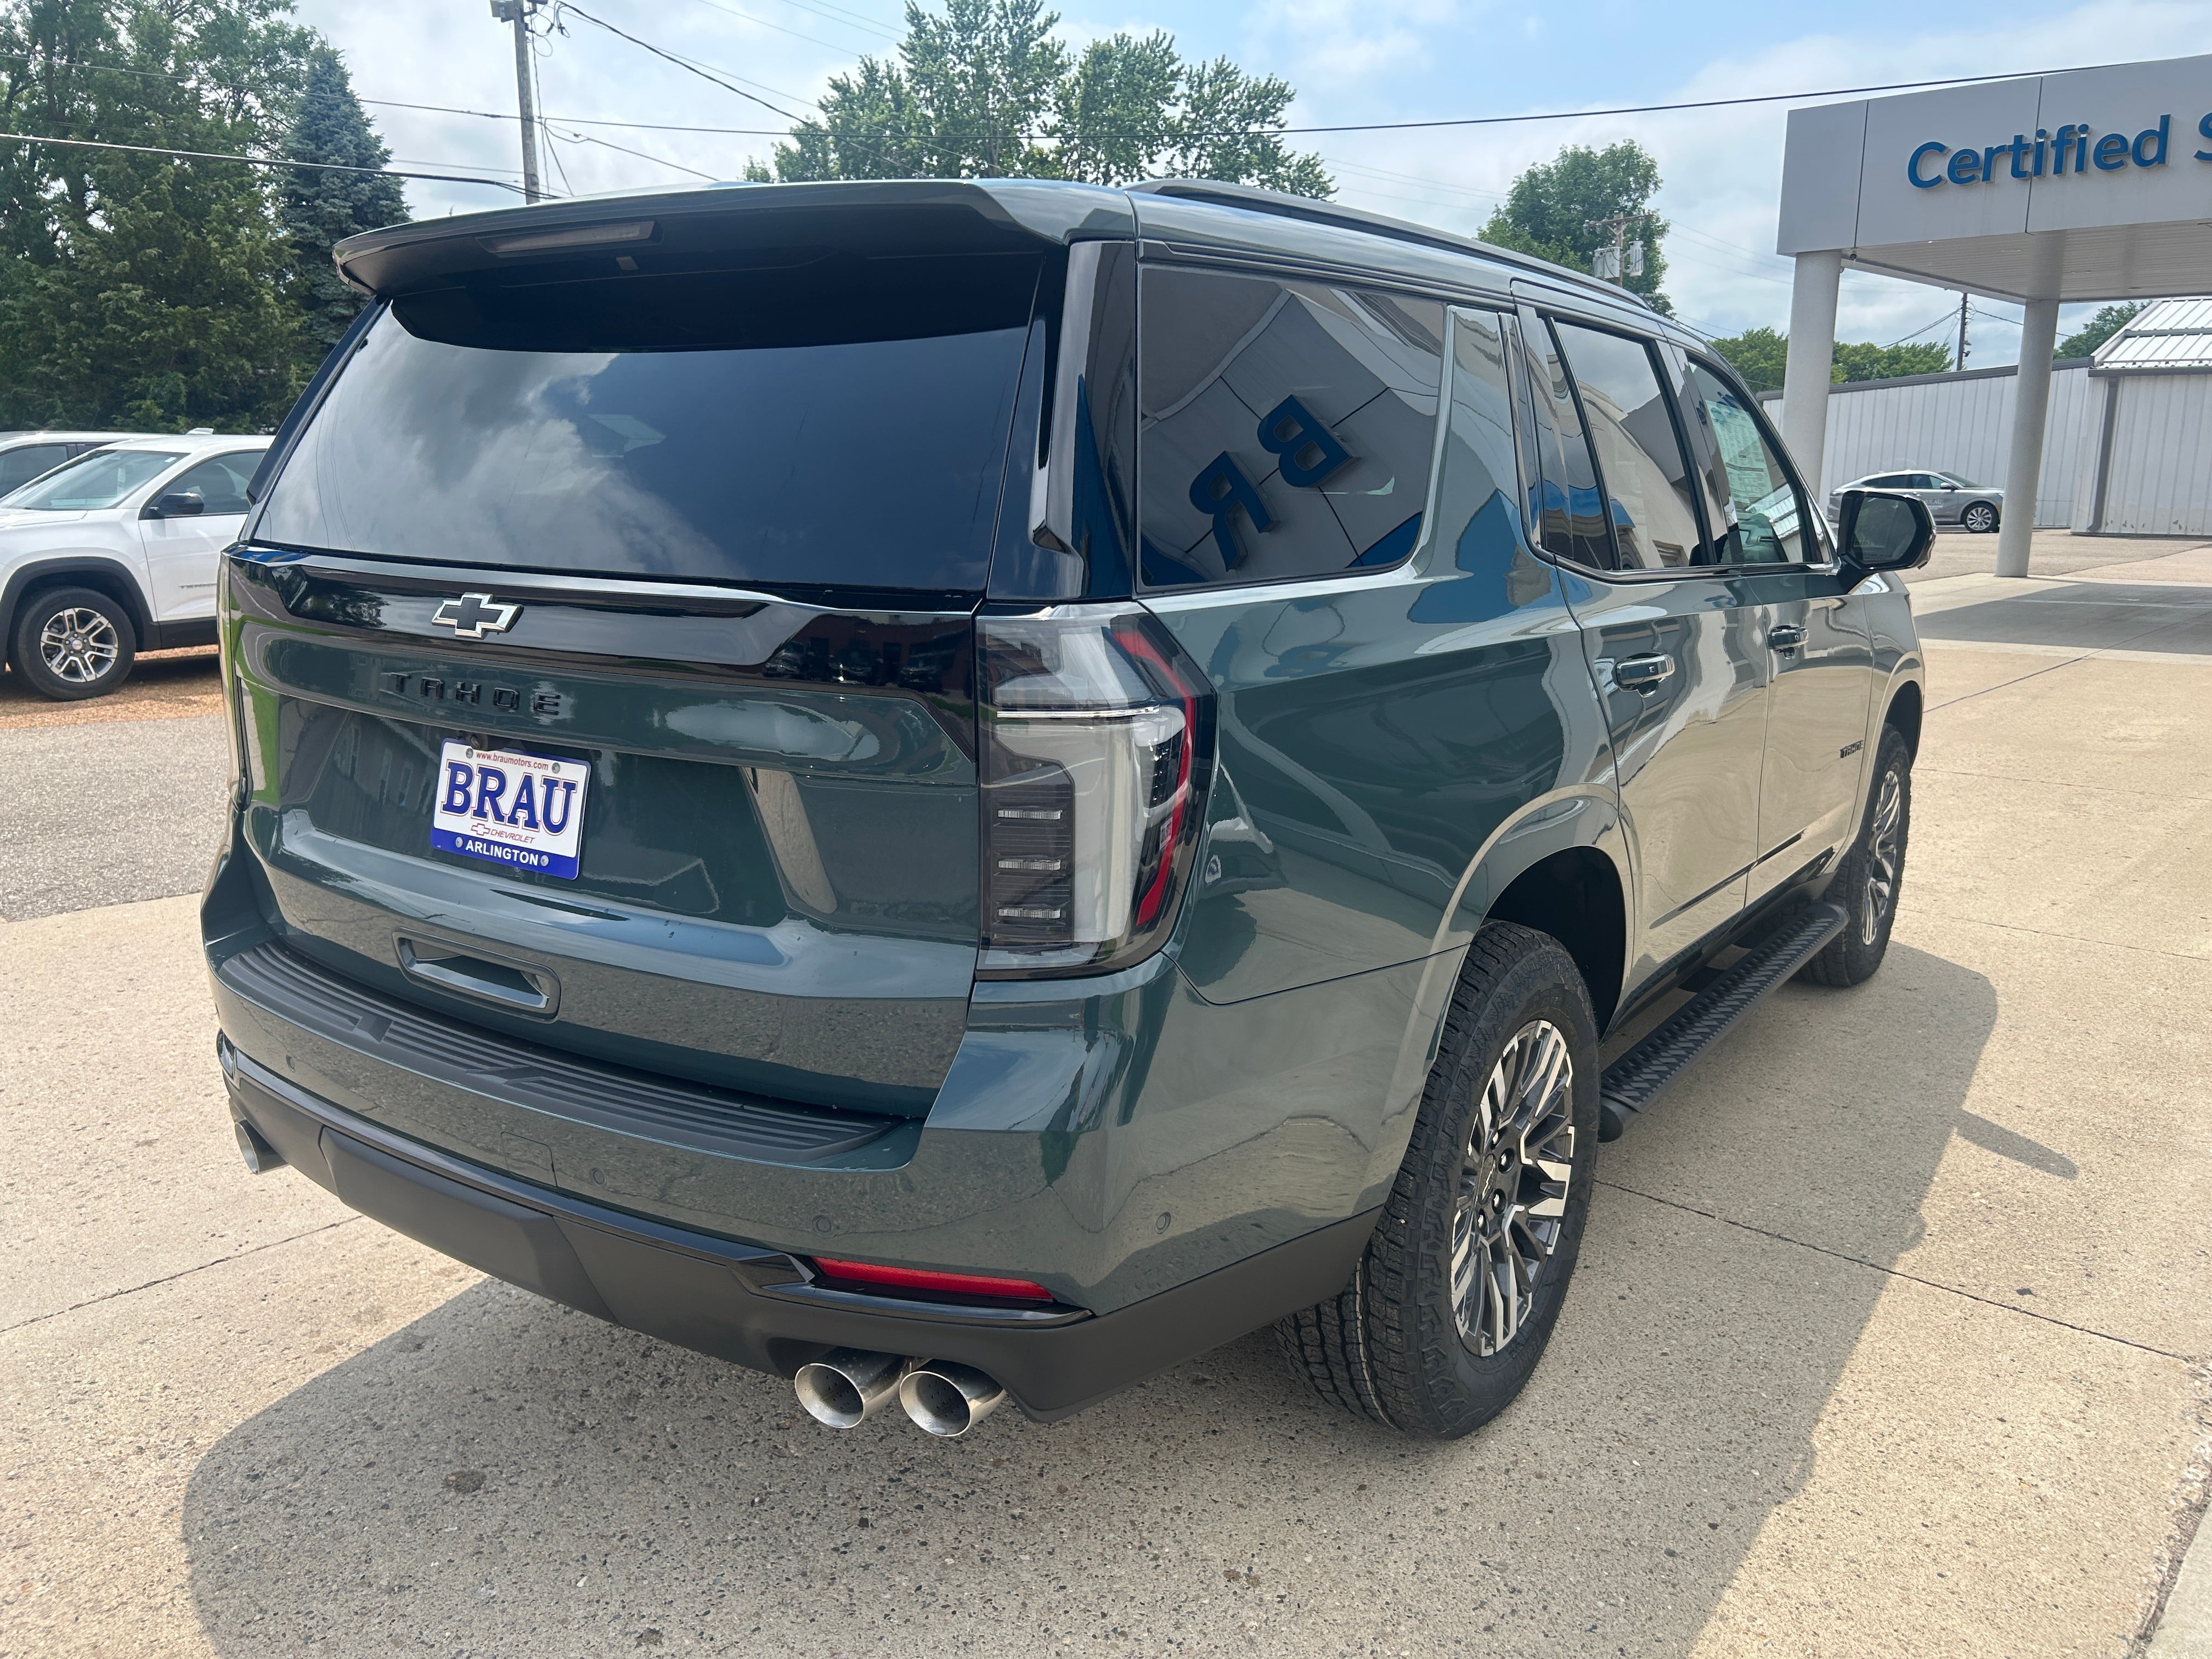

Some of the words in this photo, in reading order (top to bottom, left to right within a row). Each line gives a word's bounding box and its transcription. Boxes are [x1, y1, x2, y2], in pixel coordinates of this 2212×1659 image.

[1908, 114, 2171, 189] Certified
[387, 672, 561, 715] TAHOE
[476, 752, 549, 771] www.braumotors.com
[1839, 740, 1864, 758] TAHOE
[440, 759, 578, 836] BRAU
[490, 829, 535, 844] CHEVROLET
[465, 839, 538, 866] ARLINGTON
